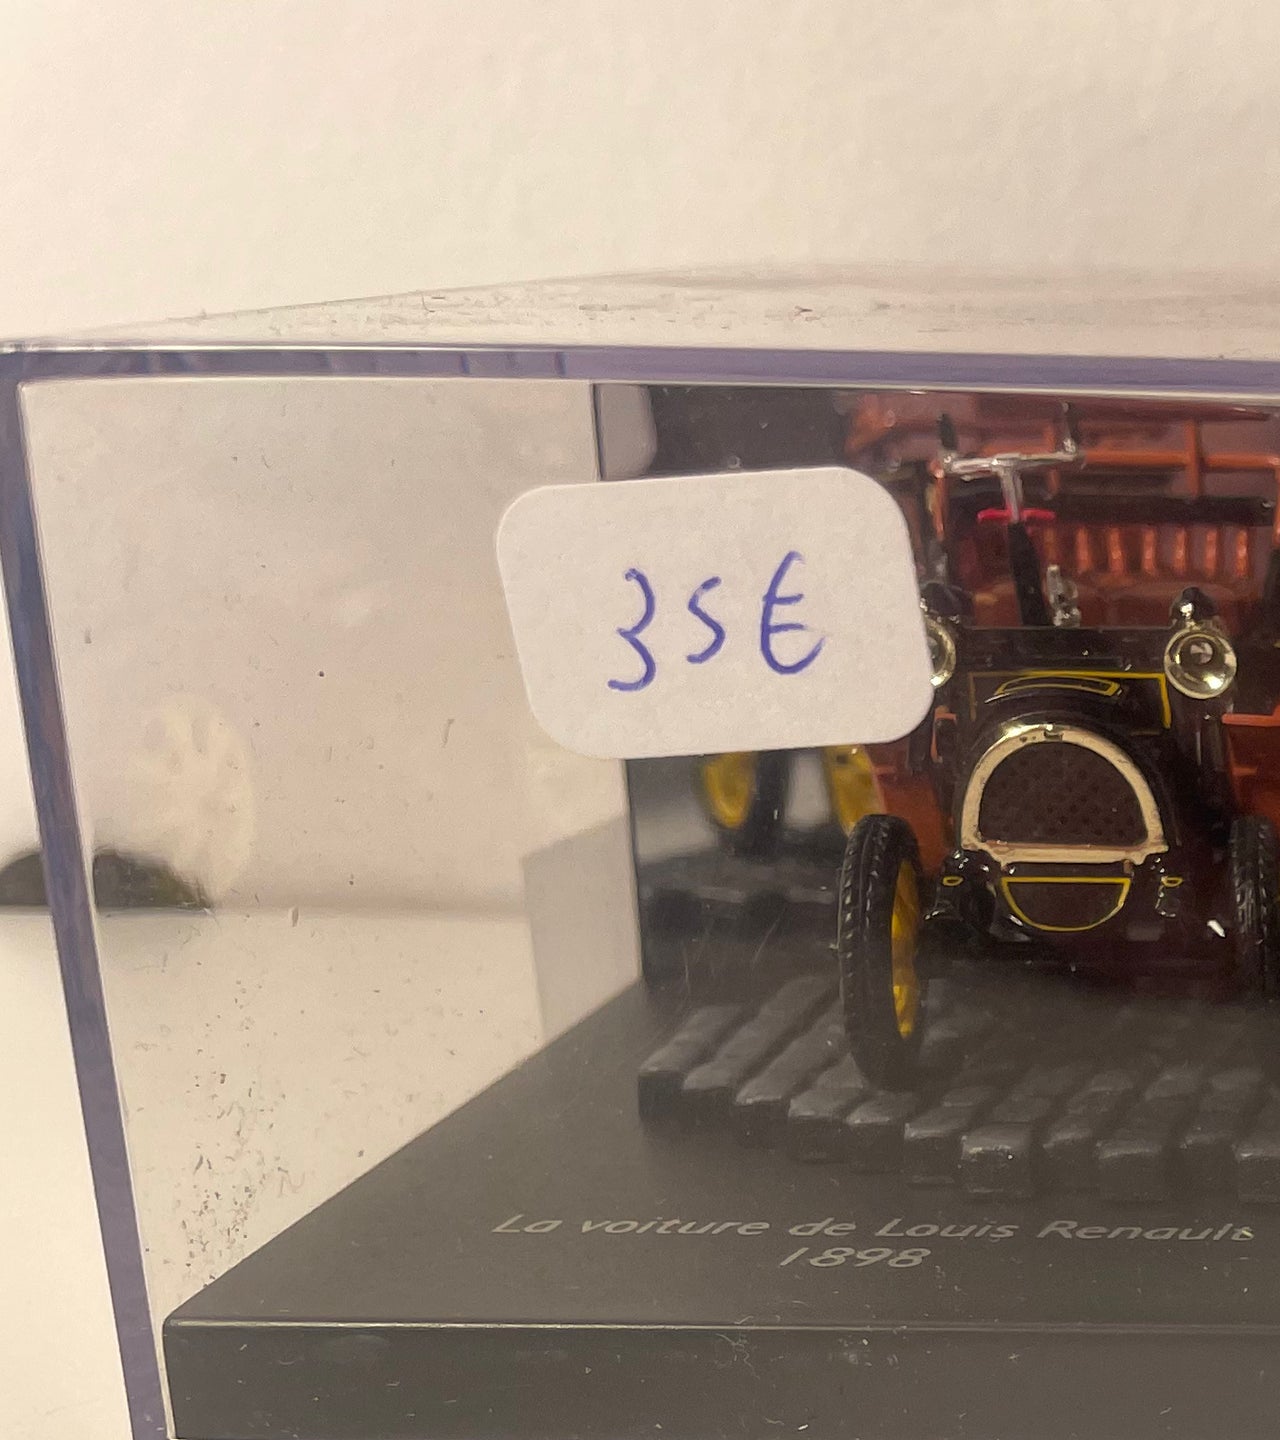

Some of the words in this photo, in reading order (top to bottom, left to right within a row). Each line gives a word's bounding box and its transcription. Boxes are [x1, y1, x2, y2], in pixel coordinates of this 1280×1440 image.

[491, 1213, 561, 1236] La
[580, 1216, 772, 1237] voiture
[788, 1217, 857, 1239] de
[874, 1217, 1019, 1242] Louis
[1037, 1219, 1256, 1243] Renault
[779, 1245, 932, 1270] 1898
